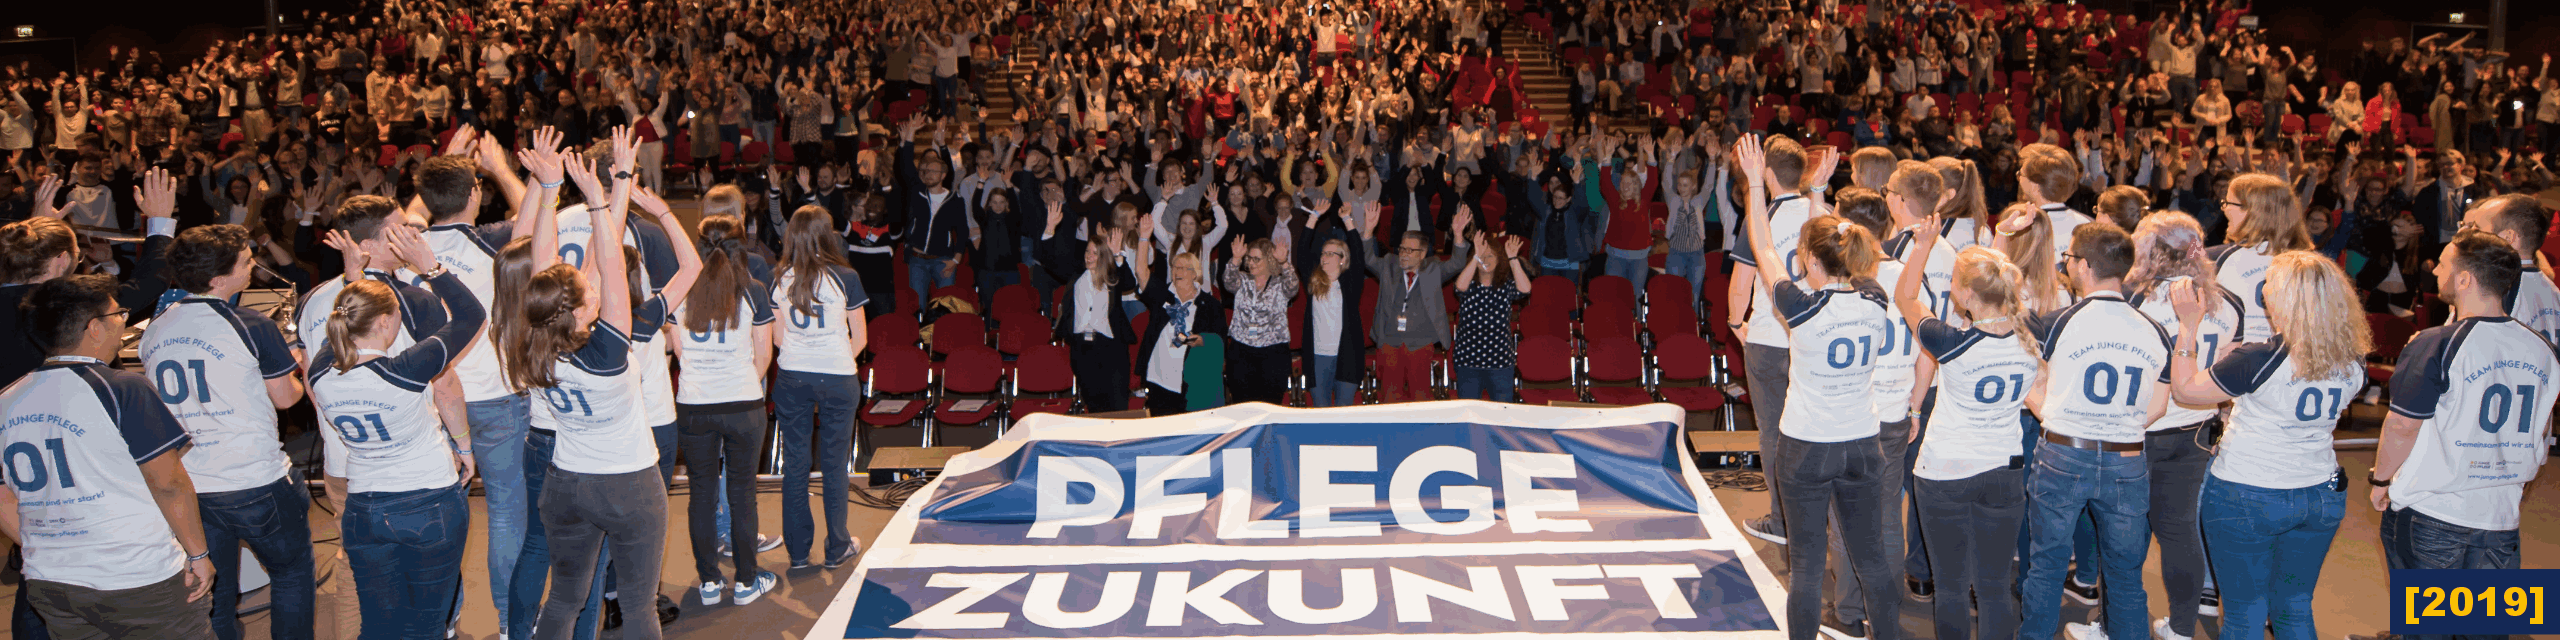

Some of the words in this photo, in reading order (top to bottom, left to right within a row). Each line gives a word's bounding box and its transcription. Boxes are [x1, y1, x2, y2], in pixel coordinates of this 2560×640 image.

[1815, 325, 1836, 339] TEAM
[1837, 320, 1859, 329] JUNGE
[163, 337, 191, 347] JUNGE
[192, 338, 226, 361] PFLEGE
[1827, 335, 1871, 370] 01
[2068, 343, 2094, 361] TEAM
[2097, 341, 2129, 352] JUNGE
[2131, 346, 2160, 370] PFLEGE
[155, 359, 212, 405] 01
[1974, 373, 2024, 404] 01
[2083, 361, 2144, 407] 01
[2465, 364, 2492, 384] TEAM
[2522, 362, 2549, 386] PFLEGE
[334, 399, 361, 409] JUNGE
[362, 399, 397, 412] PFLEGE
[544, 386, 593, 417] 01
[2063, 408, 2108, 418] Gemeinsam
[2295, 386, 2342, 422] 01
[2478, 383, 2536, 434] 01
[8, 413, 45, 428] JUNGE
[47, 415, 86, 438] PFLEGE
[333, 412, 392, 443] 01
[2455, 440, 2499, 449] Gemeinsam
[3, 437, 76, 493] 01
[78, 490, 105, 503] stark!
[1025, 444, 1593, 540] PFLEGE
[889, 563, 1703, 630] ZUKUNFT
